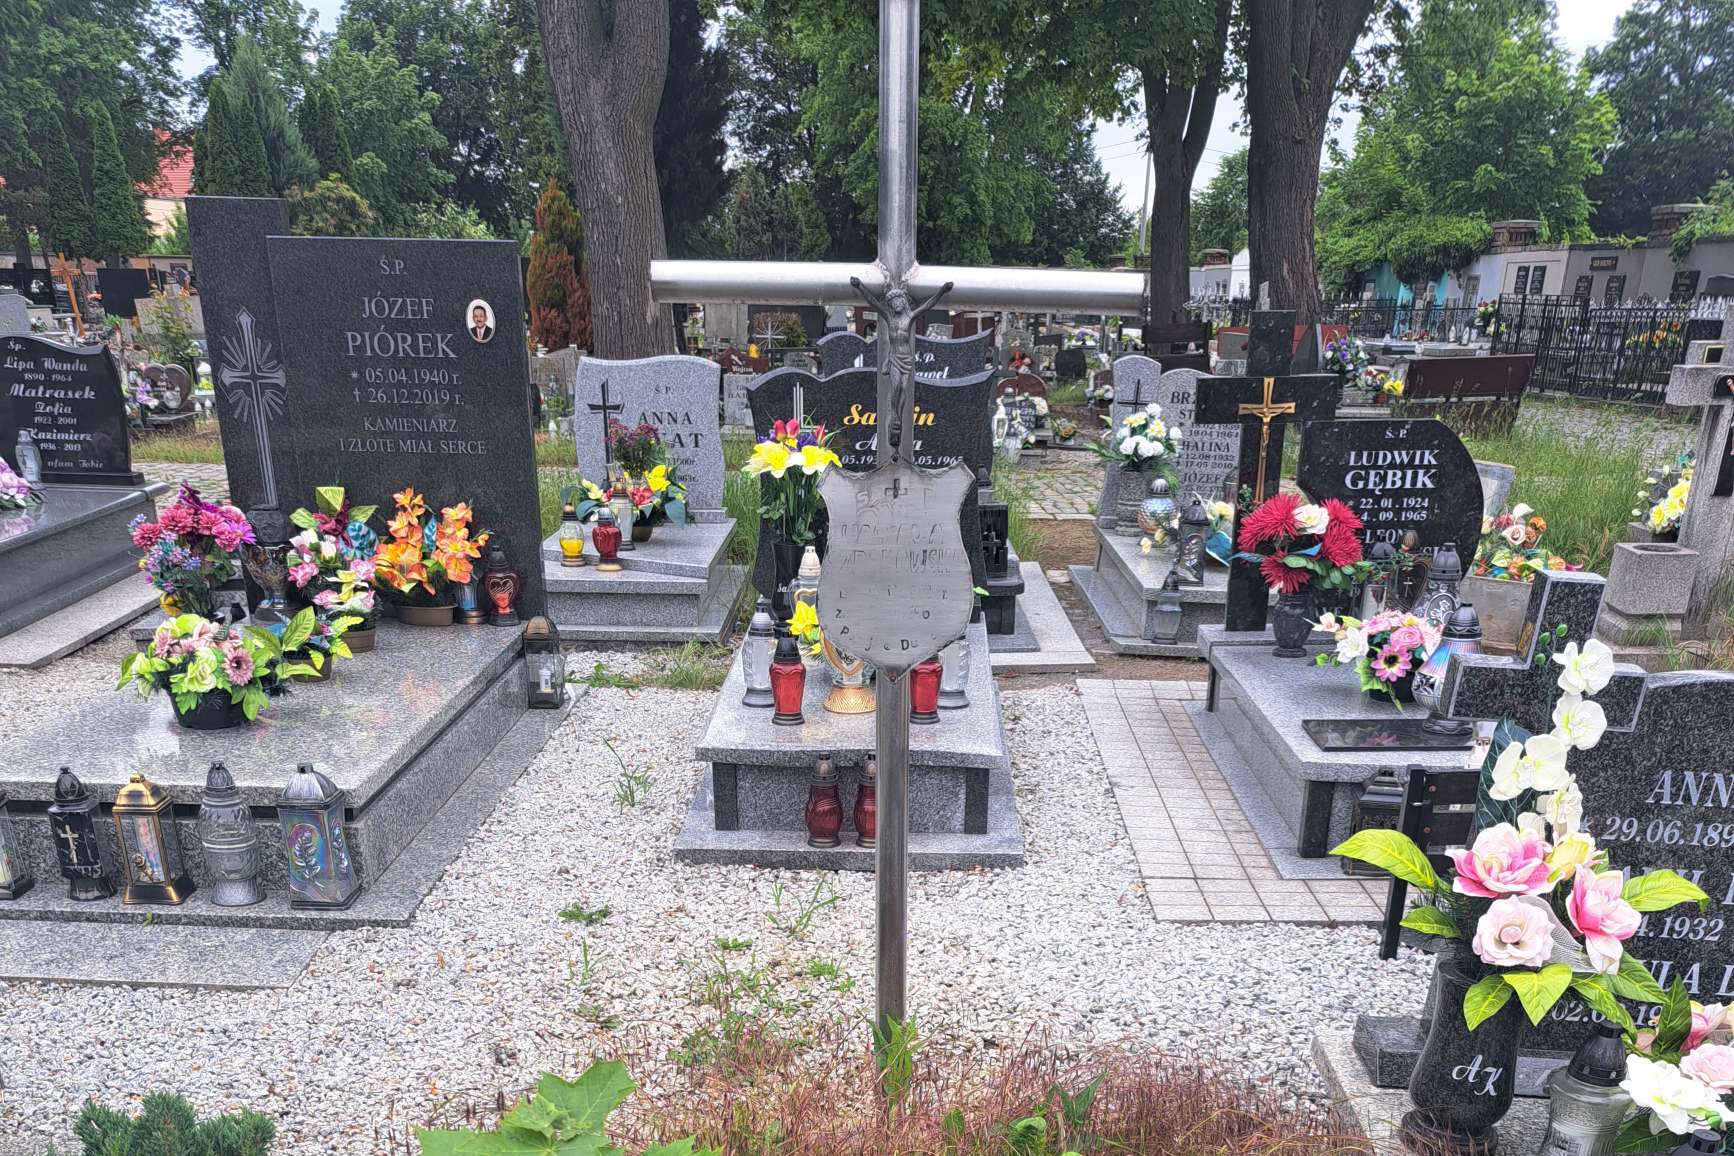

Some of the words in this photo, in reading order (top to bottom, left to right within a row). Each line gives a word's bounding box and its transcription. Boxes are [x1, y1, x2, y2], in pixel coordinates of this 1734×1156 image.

[362, 291, 434, 319] JÓZEF
[344, 325, 458, 358] PIÓREK
[4, 356, 35, 370] Lipa
[41, 358, 88, 371] Wanda
[365, 368, 449, 385] 05.04.1940
[6, 384, 96, 399] Matrasek
[367, 388, 450, 405] 26.12.2019
[1170, 391, 1197, 405] BR
[35, 402, 73, 415] Zofia
[363, 417, 458, 433] KAMIENIARZ
[637, 411, 693, 425] ANNA
[27, 428, 93, 441] Kazimierz
[349, 438, 395, 453] ZŁOTE
[400, 440, 437, 454] MIAŁ
[440, 440, 487, 456] SERCE
[1182, 440, 1231, 453] HALINA
[1348, 449, 1440, 467] LUDWIK
[1344, 468, 1440, 495] GĘBIK
[1645, 769, 1734, 809] ANN
[1601, 816, 1734, 849] 29.06.189
